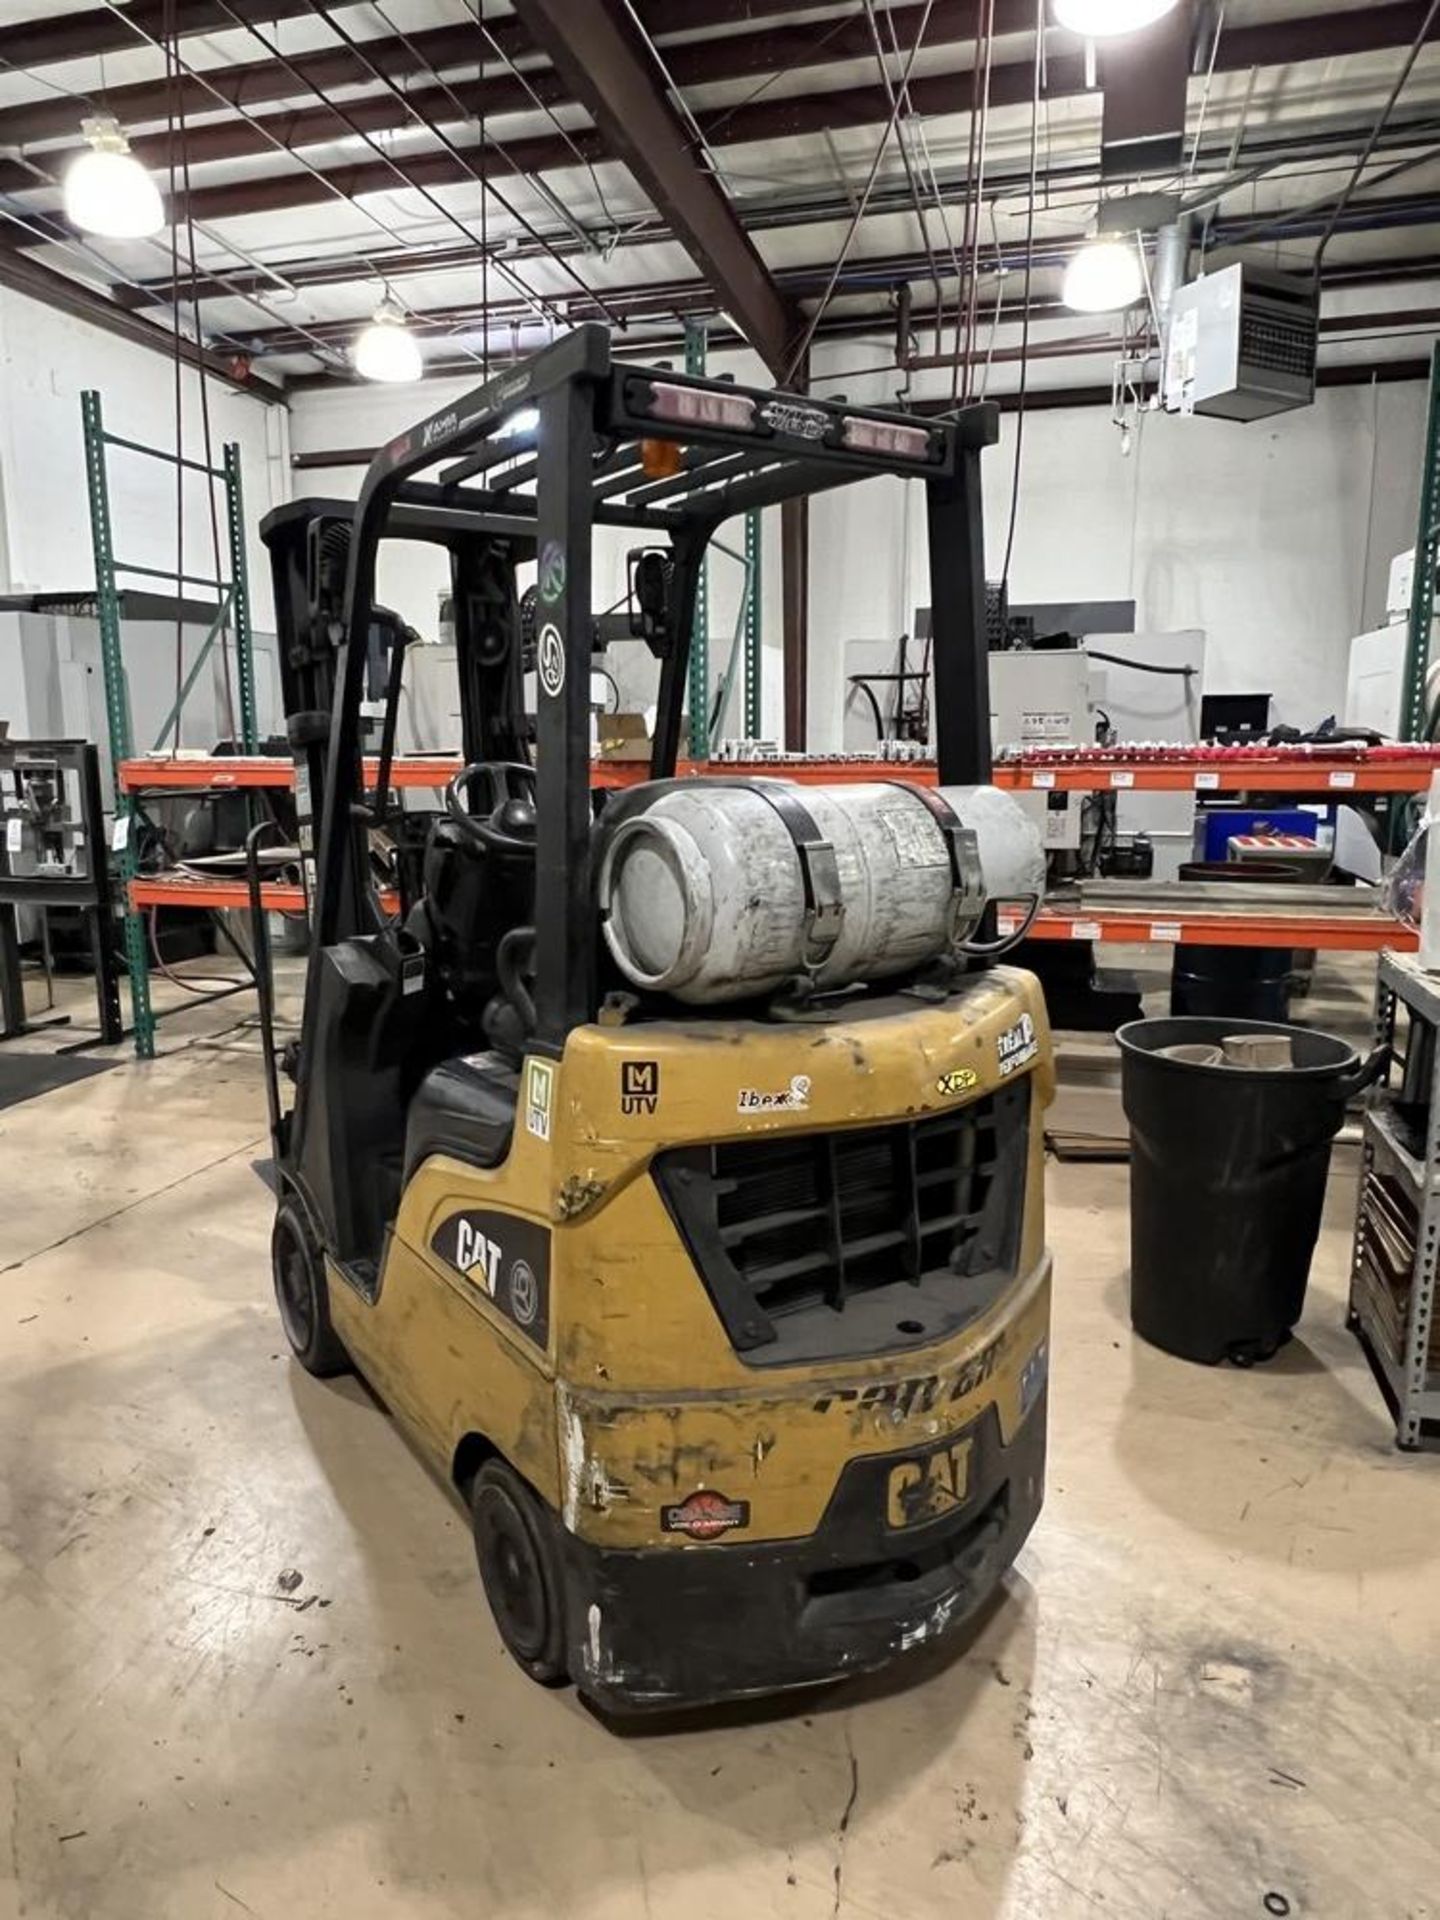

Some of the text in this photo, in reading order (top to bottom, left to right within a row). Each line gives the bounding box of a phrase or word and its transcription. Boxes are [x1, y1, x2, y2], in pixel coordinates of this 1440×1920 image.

[627, 1065, 653, 1092] LM
[622, 1098, 657, 1115] UTV
[457, 1218, 502, 1298] CAT
[886, 1438, 974, 1529] CAT
